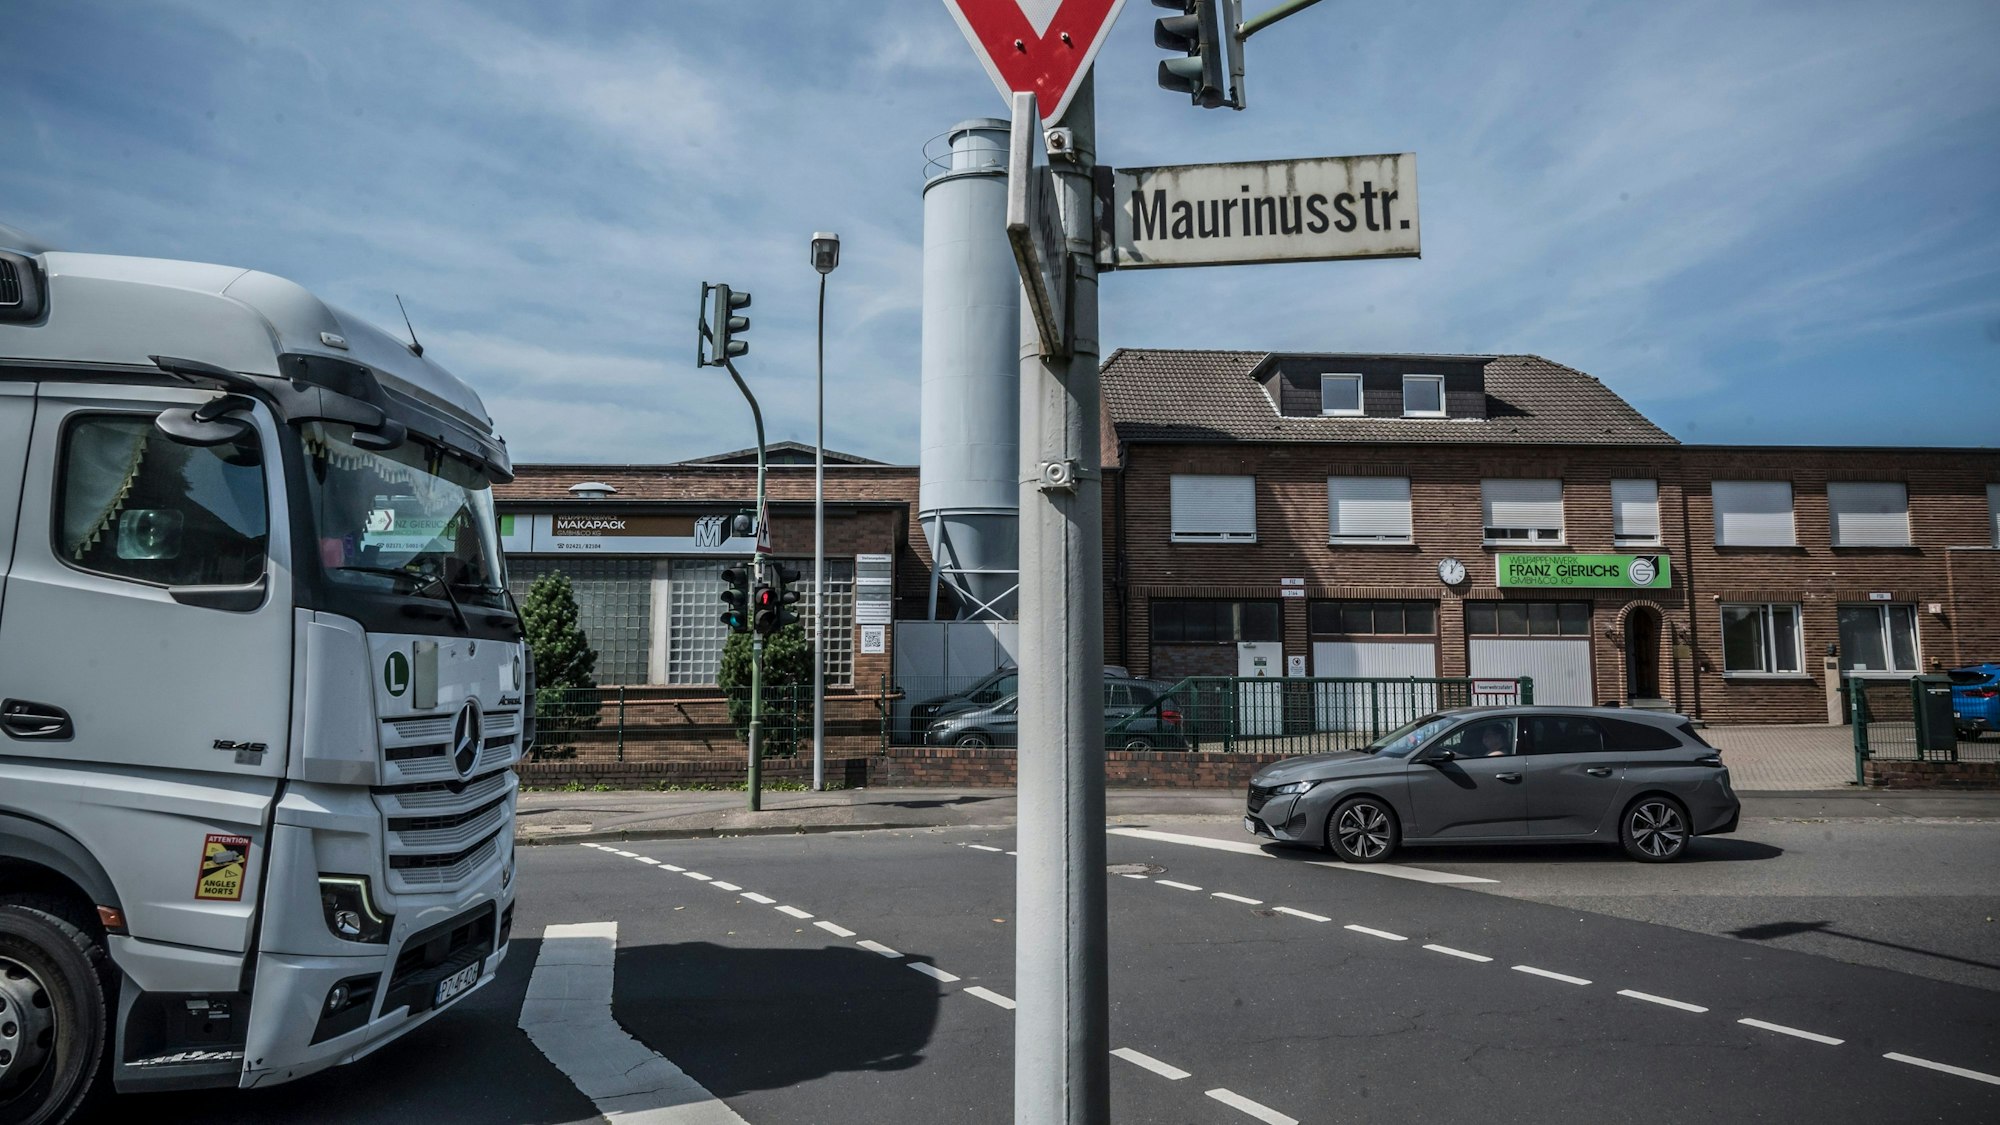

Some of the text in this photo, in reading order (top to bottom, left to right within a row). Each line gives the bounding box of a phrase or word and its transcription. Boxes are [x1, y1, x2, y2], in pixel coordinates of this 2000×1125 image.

[1131, 181, 1411, 241] Maurinusstr.
[557, 520, 626, 529] MAKAPACK
[1509, 556, 1579, 564] WELLPAPPENWERK
[1509, 564, 1620, 577] FRANZ GIERLICHS
[390, 657, 405, 692] L
[213, 739, 268, 752] 1845
[208, 835, 249, 844] ATTENTION
[203, 879, 237, 888] ANGLES
[204, 887, 234, 895] MORTS
